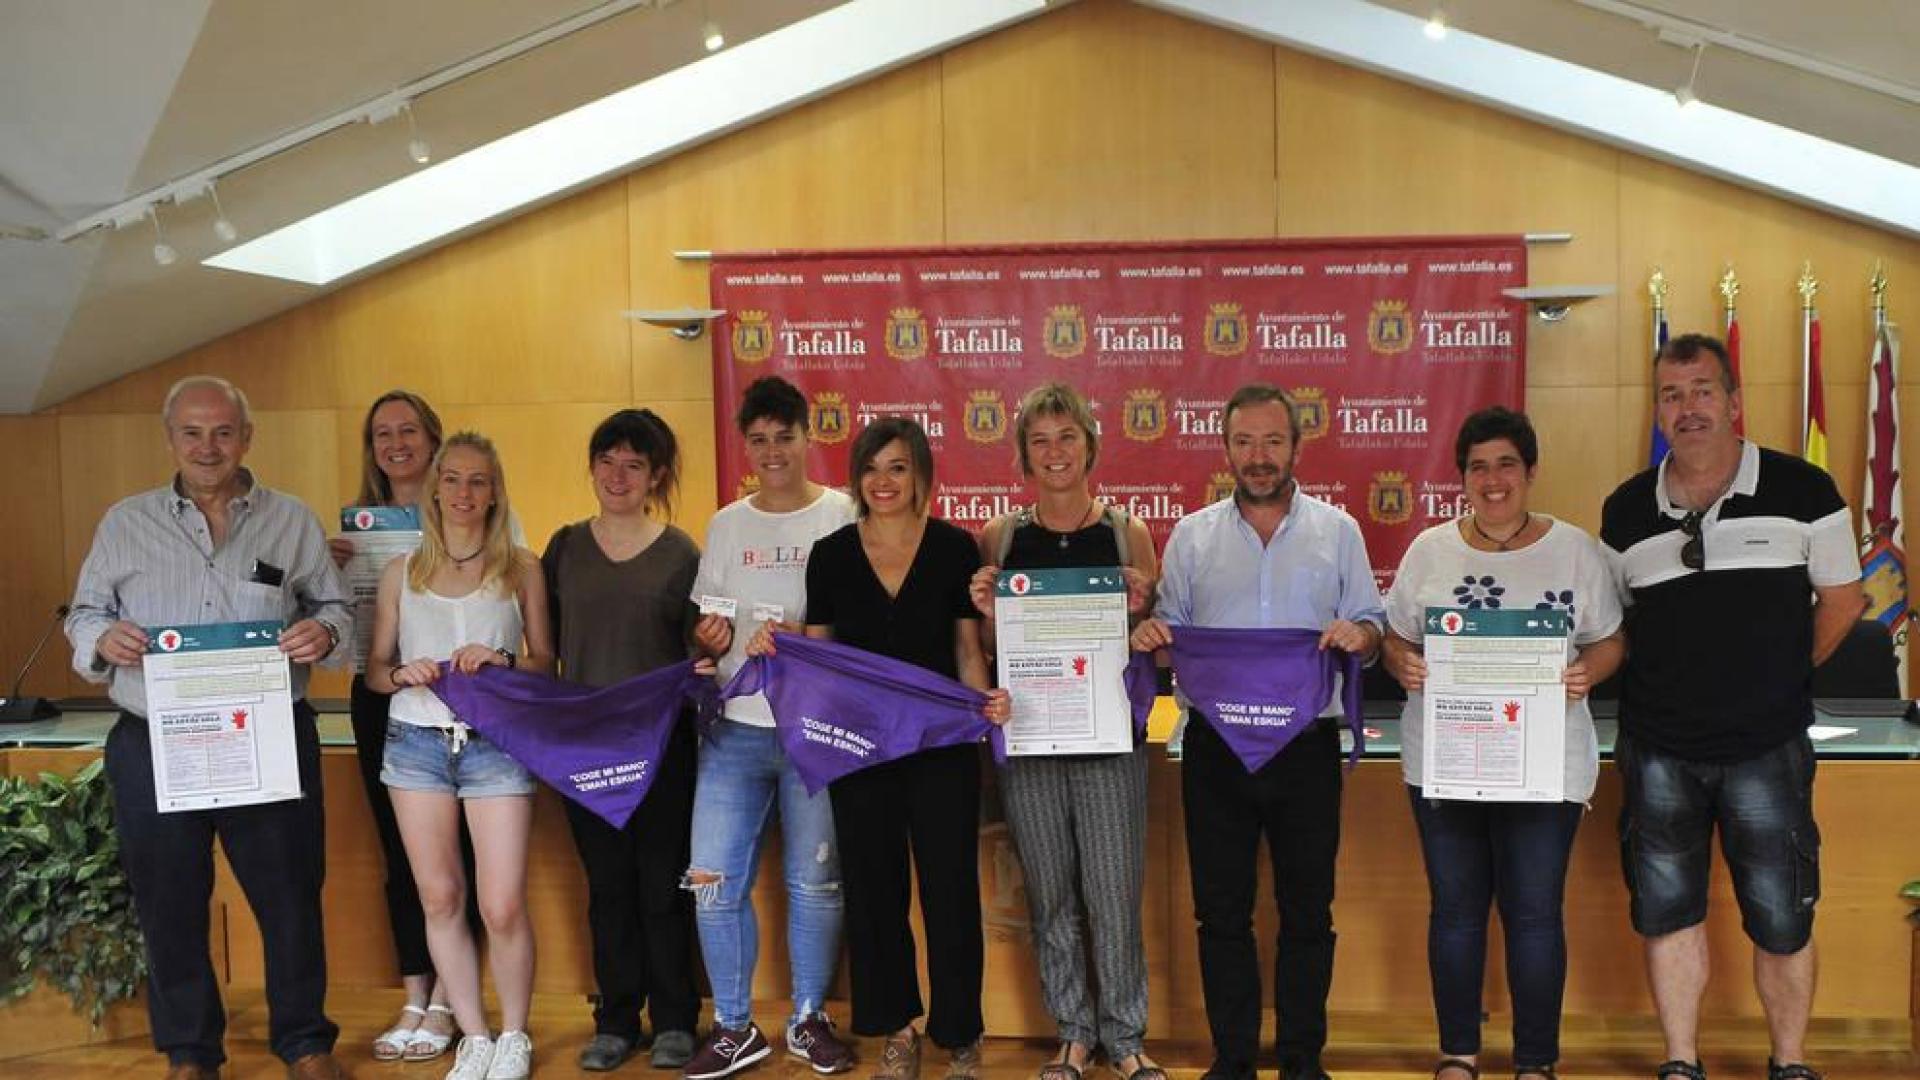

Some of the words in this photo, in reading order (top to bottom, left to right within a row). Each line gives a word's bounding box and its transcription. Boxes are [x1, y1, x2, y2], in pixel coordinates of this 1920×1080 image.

[1120, 266, 1202, 278] www.tafalla.es
[1222, 264, 1304, 276] www.tafalla.es
[1324, 262, 1408, 275] www.tafalla.es
[1428, 261, 1512, 273] www.tafalla.es
[726, 274, 803, 286] www.tafalla.es
[822, 272, 900, 284] www.tafalla.es
[920, 270, 1000, 282] www.tafalla.es
[1020, 268, 1100, 280] www.tafalla.es
[1095, 314, 1166, 325] Ayuntamiento
[1168, 313, 1182, 324] de
[1257, 311, 1328, 324] Ayuntamiento
[1331, 310, 1346, 322] de
[1421, 310, 1496, 321] Ayuntamiento
[1499, 308, 1512, 319] de
[781, 319, 849, 332] Ayuntamiento
[852, 318, 864, 328] de
[936, 316, 1004, 328] Ayuntamiento
[1008, 316, 1021, 326] de
[1094, 326, 1184, 350] Tafalla
[1256, 324, 1346, 350] Tafalla
[1420, 321, 1512, 347] Tafalla
[780, 330, 866, 356] Tafalla
[935, 328, 1023, 354] Tafalla
[929, 400, 943, 410] de
[1337, 396, 1410, 408] Ayuntamiento
[1414, 395, 1426, 406] de
[1336, 408, 1428, 433] Tafalla
[938, 482, 1008, 494] Ayuntamiento
[1010, 482, 1023, 493] de
[1096, 482, 1168, 494] Ayuntamiento
[1170, 482, 1182, 492] de
[1420, 494, 1475, 518] Tafa
[1249, 705, 1261, 714] MI
[832, 726, 846, 736] MI
[602, 767, 614, 776] MI
